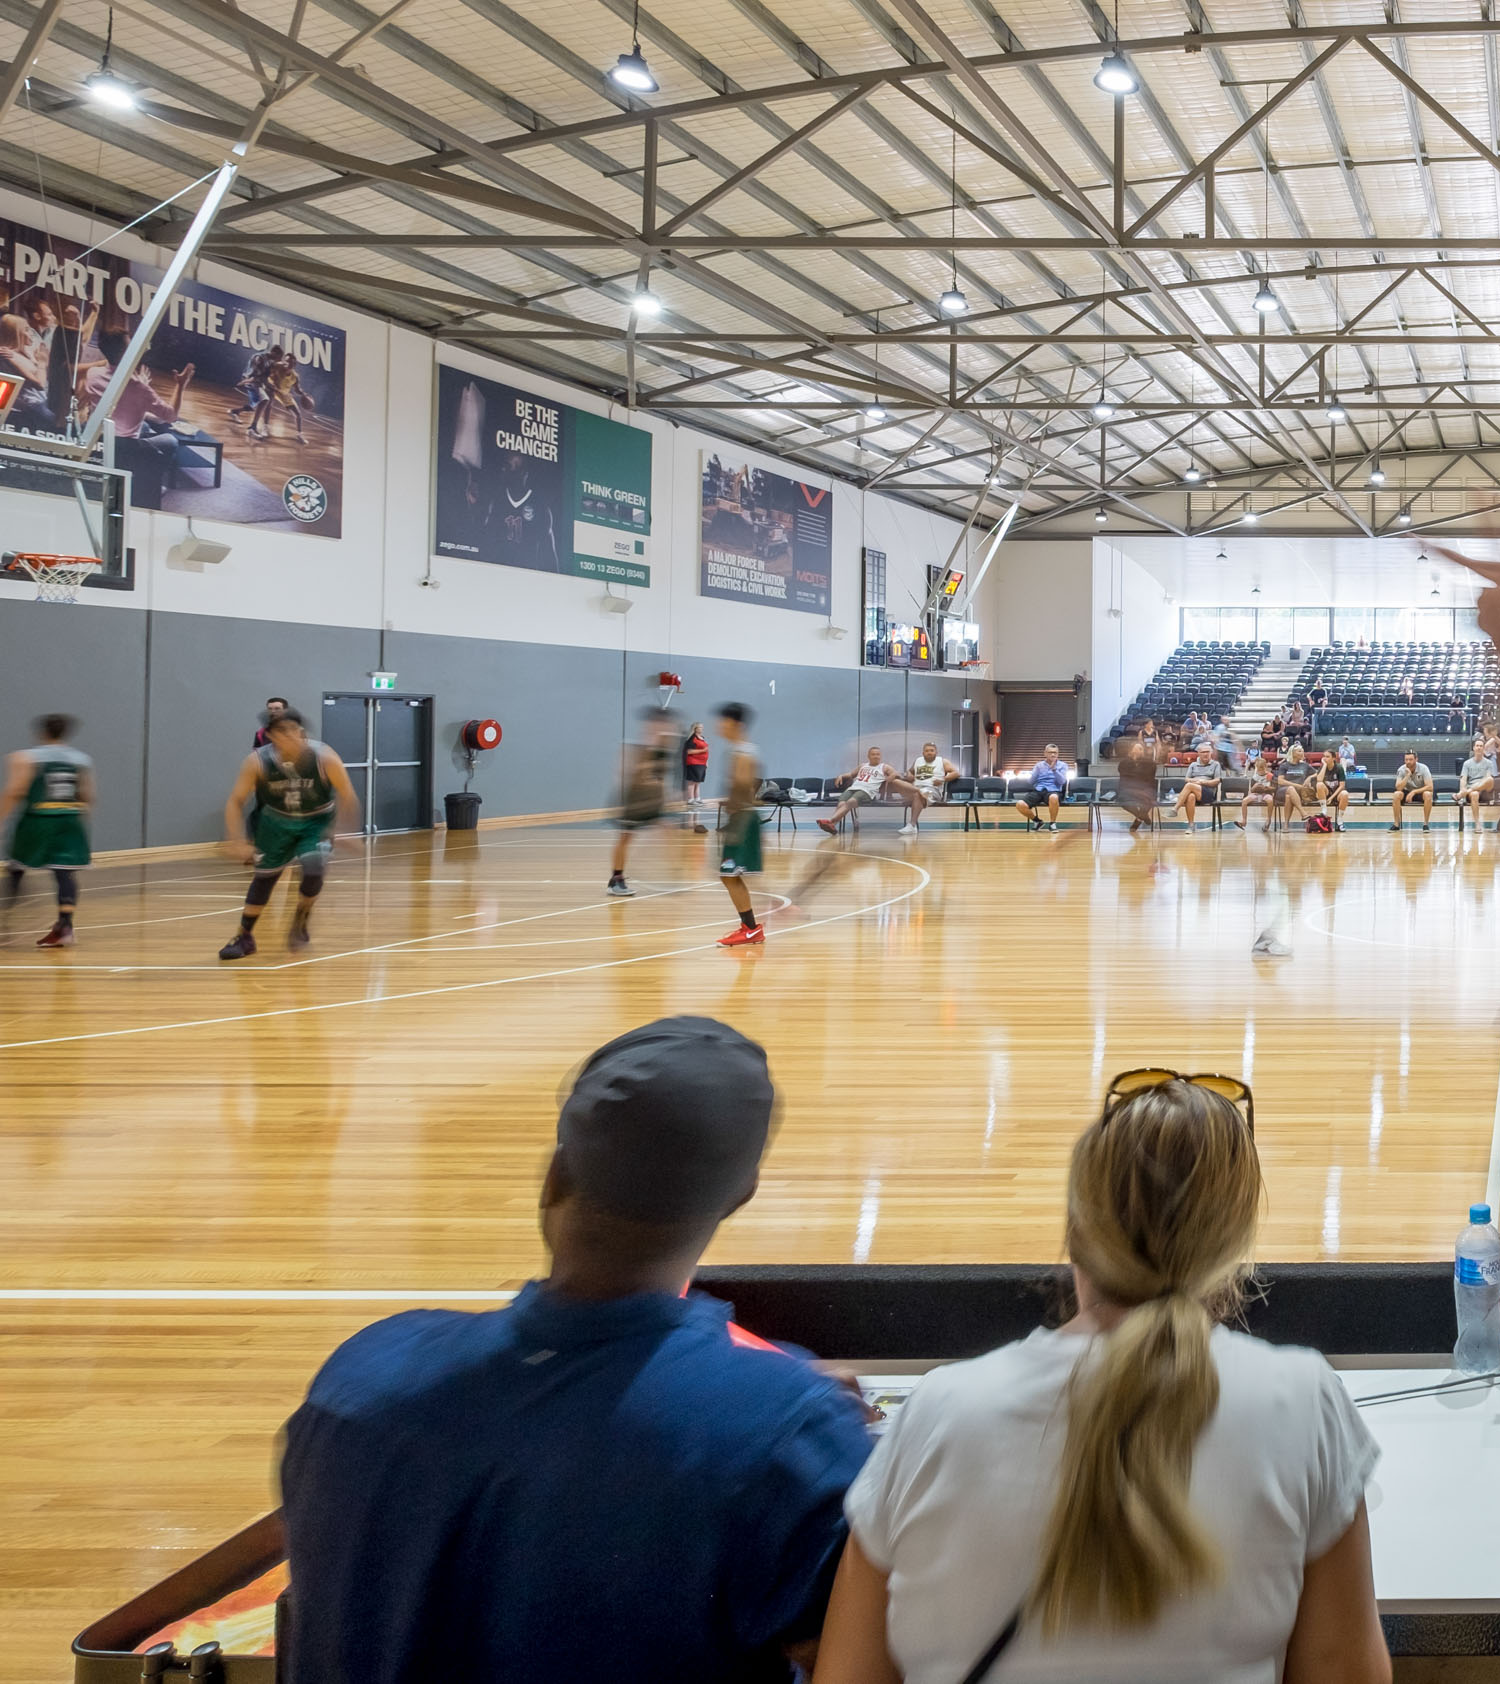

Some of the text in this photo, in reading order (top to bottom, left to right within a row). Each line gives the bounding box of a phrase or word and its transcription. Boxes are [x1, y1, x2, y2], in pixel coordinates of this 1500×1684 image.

[14, 242, 110, 305] PART
[165, 293, 225, 341] THE
[229, 313, 333, 372] ACTION
[515, 399, 559, 428] BE THE
[521, 418, 559, 445] GAME
[496, 429, 558, 463] CHANGER
[581, 480, 646, 507] THINK GREEN
[614, 542, 630, 551] ZEGO
[580, 561, 596, 571] 1300
[597, 564, 605, 573] 13
[606, 564, 625, 576] ZEGO
[708, 550, 714, 561] A
[714, 550, 737, 567] MAJOR
[737, 554, 757, 570] FORCE
[708, 562, 786, 588] DEMOLITION, EXCAVATION,
[708, 574, 741, 592] LOGISTICS
[741, 580, 748, 593] &
[748, 582, 764, 596] CIVIL
[768, 679, 776, 696] 1
